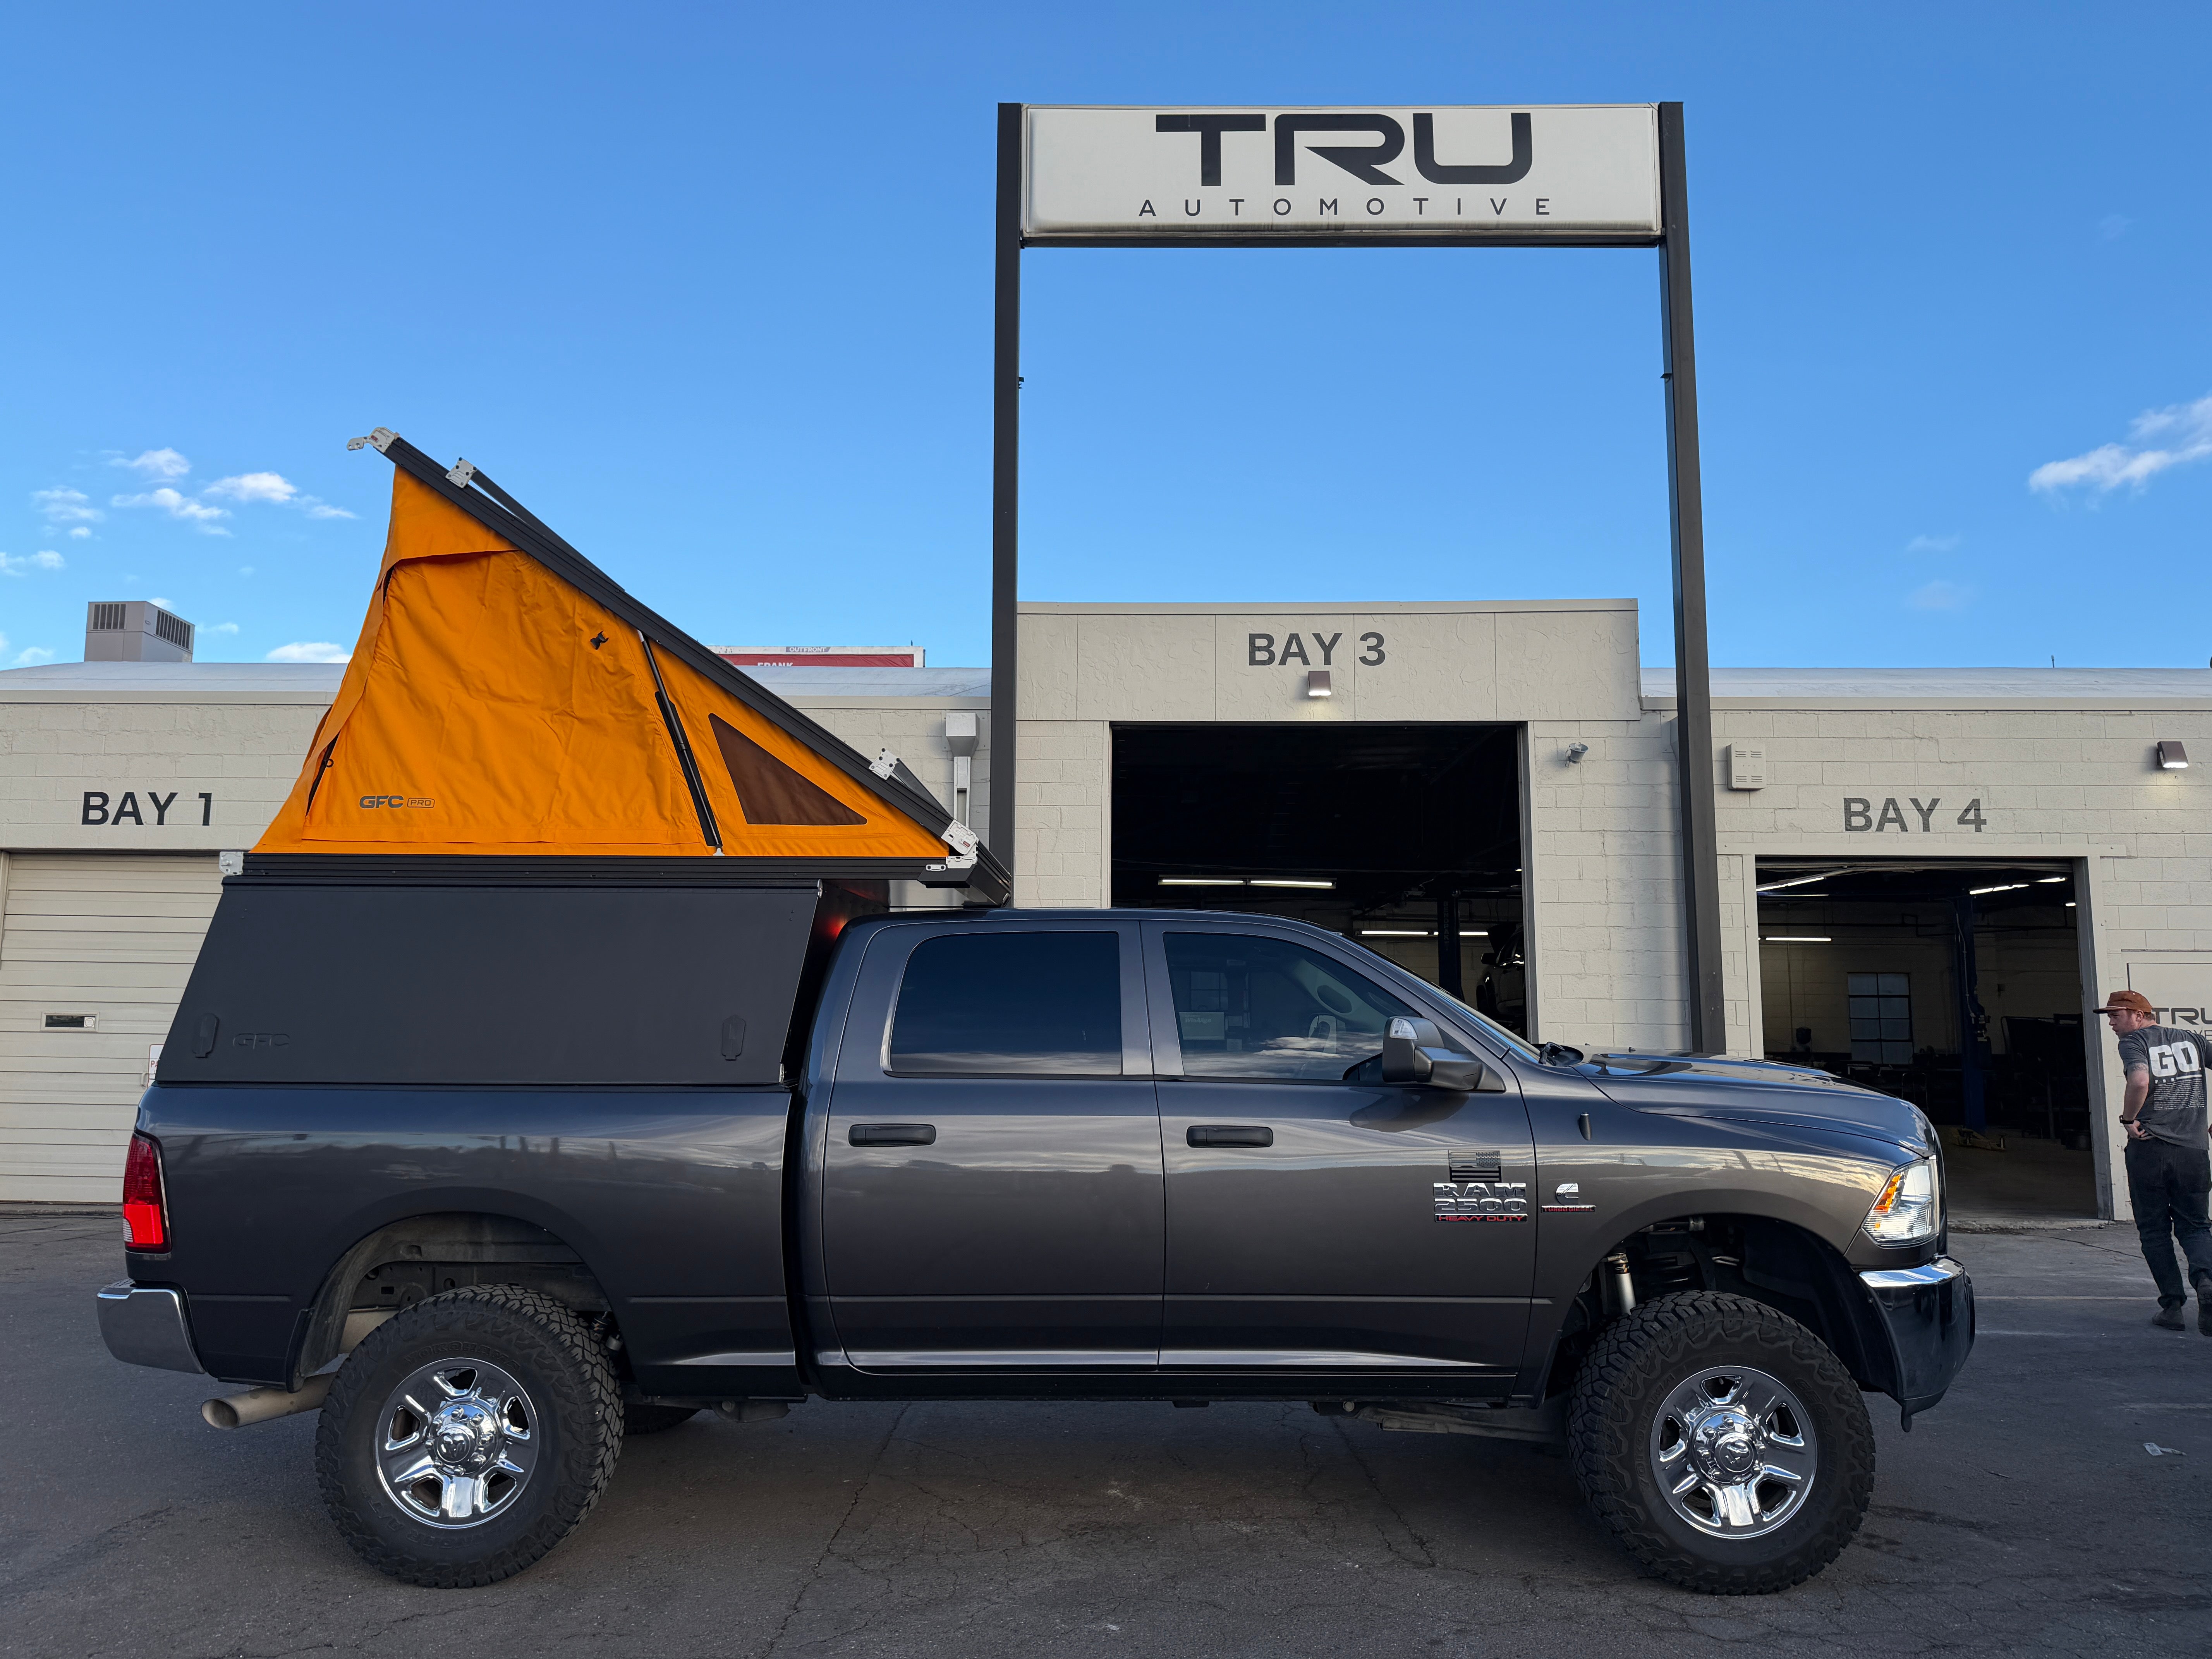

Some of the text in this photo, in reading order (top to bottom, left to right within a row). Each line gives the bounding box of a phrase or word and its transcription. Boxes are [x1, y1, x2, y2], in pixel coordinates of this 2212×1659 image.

[1156, 112, 1532, 186] TRU
[1138, 196, 1551, 217] AUTOMOTIVE
[1249, 632, 1386, 666] BAY 3
[81, 791, 212, 826] BAY 1
[359, 795, 404, 809] GFC
[1843, 797, 1987, 832] BAY 4
[1433, 1182, 1526, 1197] RAM
[1434, 1198, 1527, 1212] 2500
[404, 1341, 520, 1372] YOKOHAMA
[1634, 1373, 1676, 1489] YOKOHAMA
